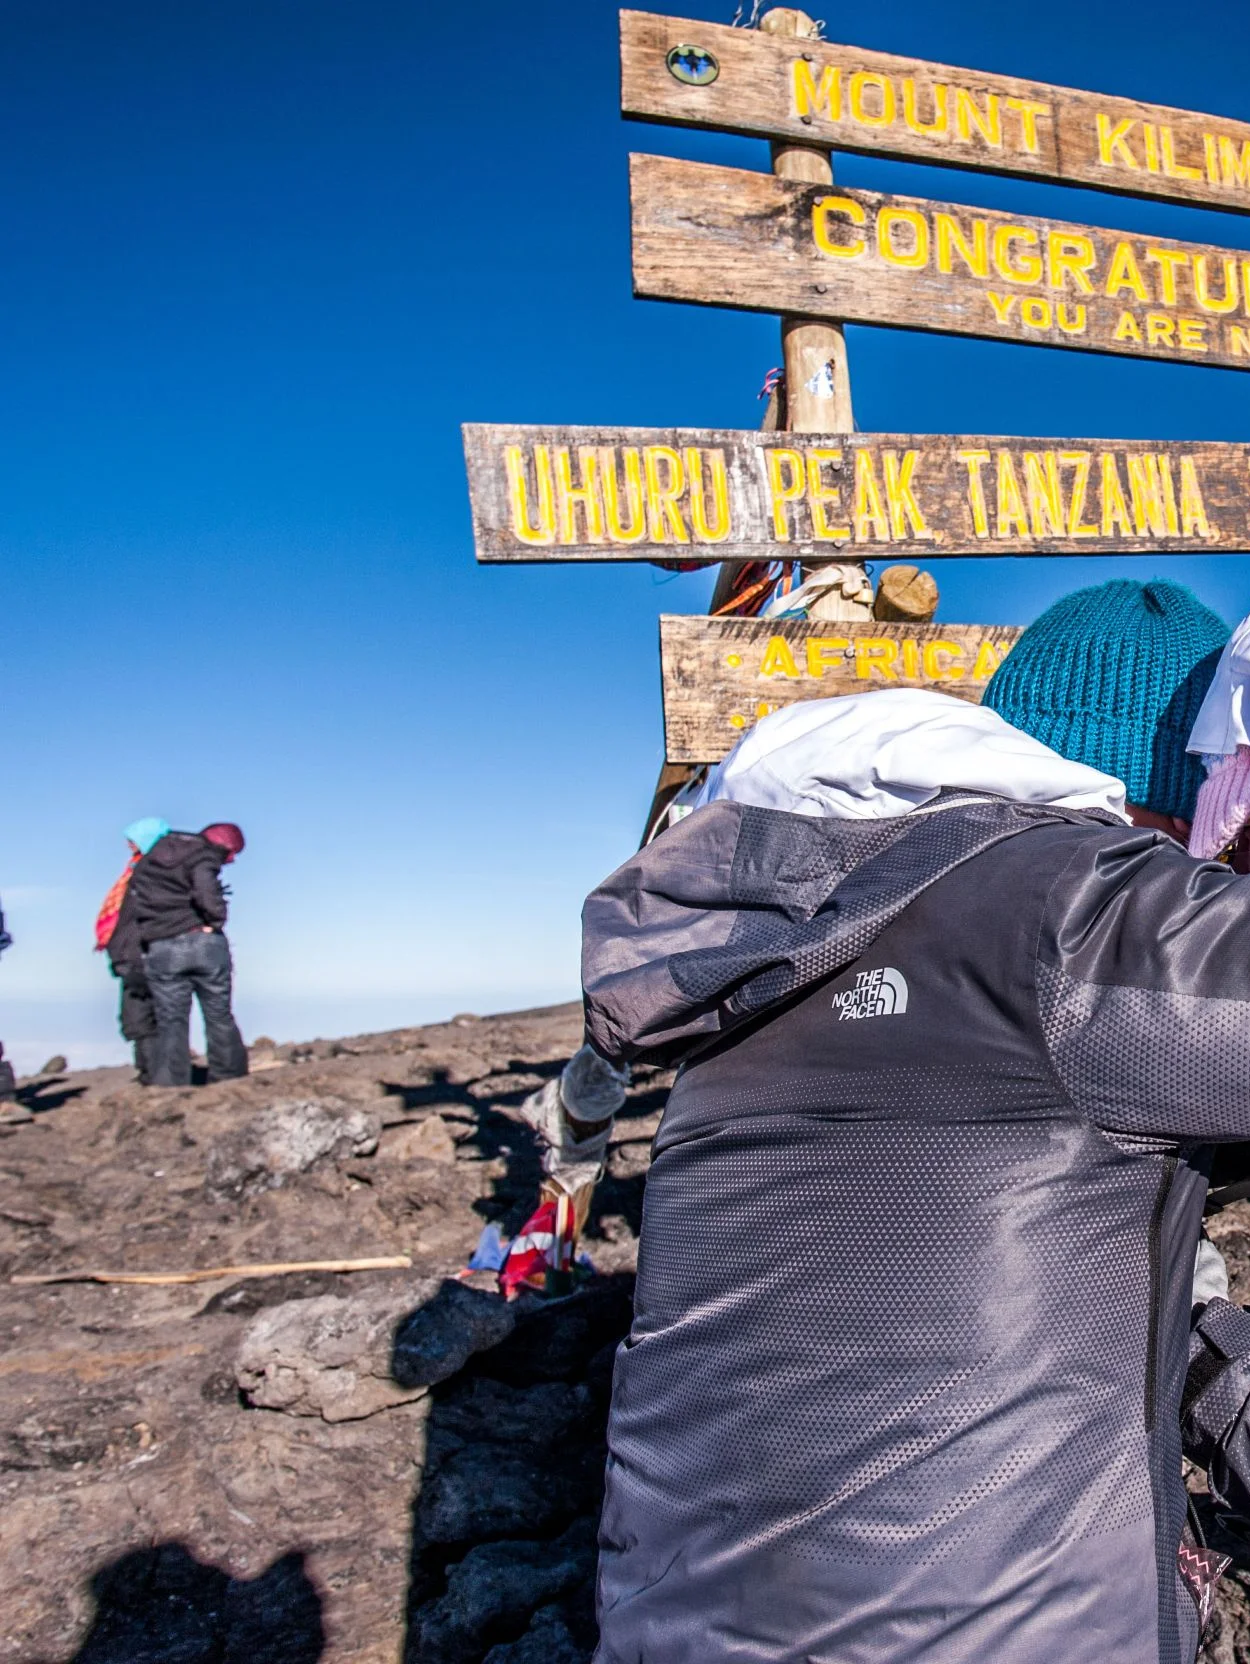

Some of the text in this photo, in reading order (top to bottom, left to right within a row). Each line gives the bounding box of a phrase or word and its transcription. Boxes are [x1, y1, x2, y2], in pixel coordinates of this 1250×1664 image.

[791, 58, 1050, 154] MOUNT
[986, 290, 1088, 334] YOU
[1114, 310, 1209, 353] ARE
[503, 444, 733, 546] UHURU
[831, 985, 880, 1008] NORTH
[857, 968, 883, 987] THE
[838, 1001, 876, 1020] FACE
